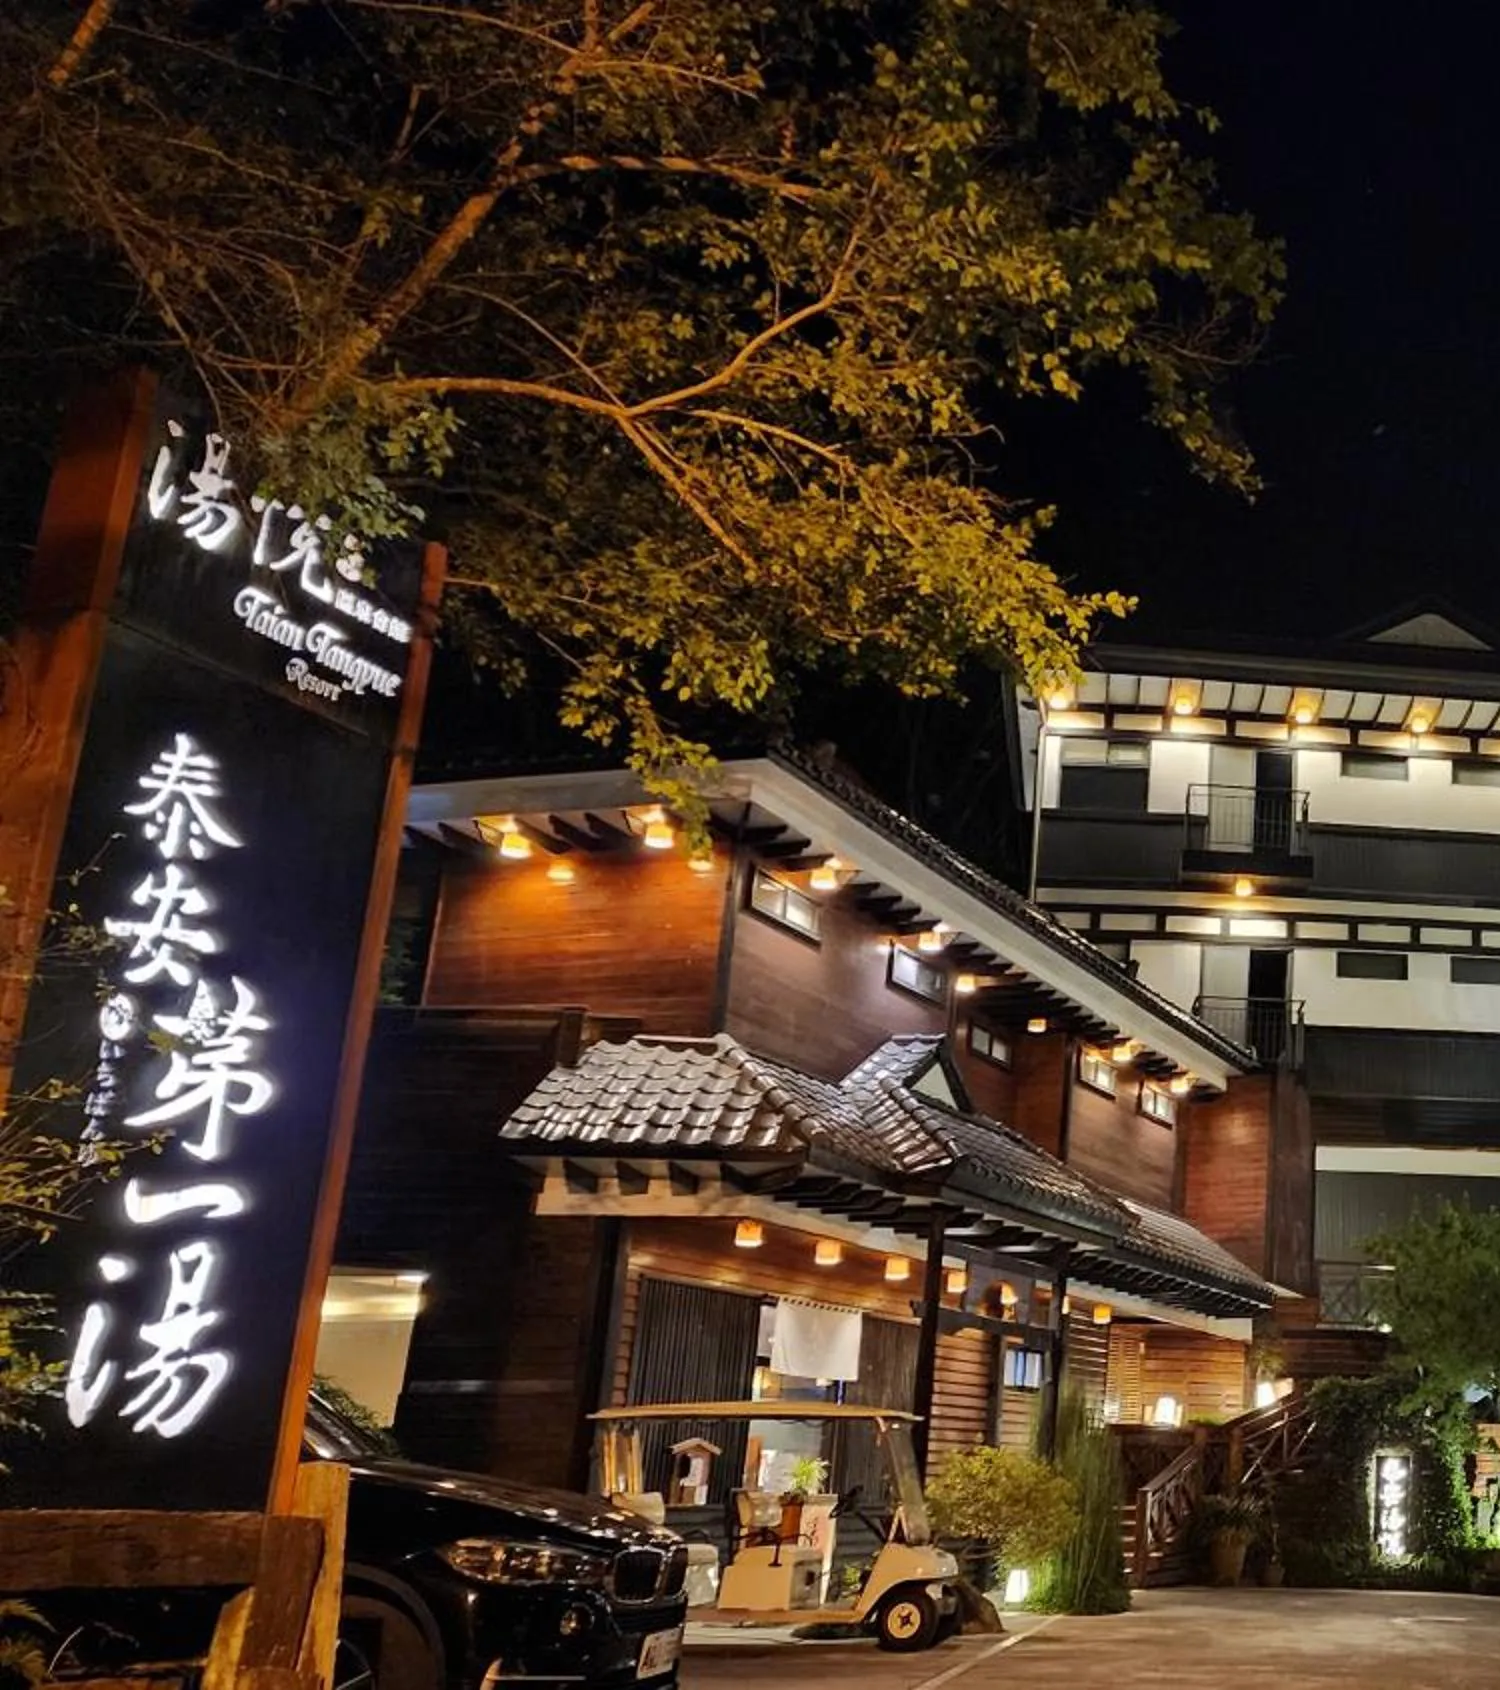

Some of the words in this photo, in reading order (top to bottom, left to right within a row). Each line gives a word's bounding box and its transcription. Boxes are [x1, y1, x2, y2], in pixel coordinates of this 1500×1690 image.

[234, 587, 306, 650] Taian
[306, 623, 402, 697] Tangyue
[285, 658, 342, 700] Resort
